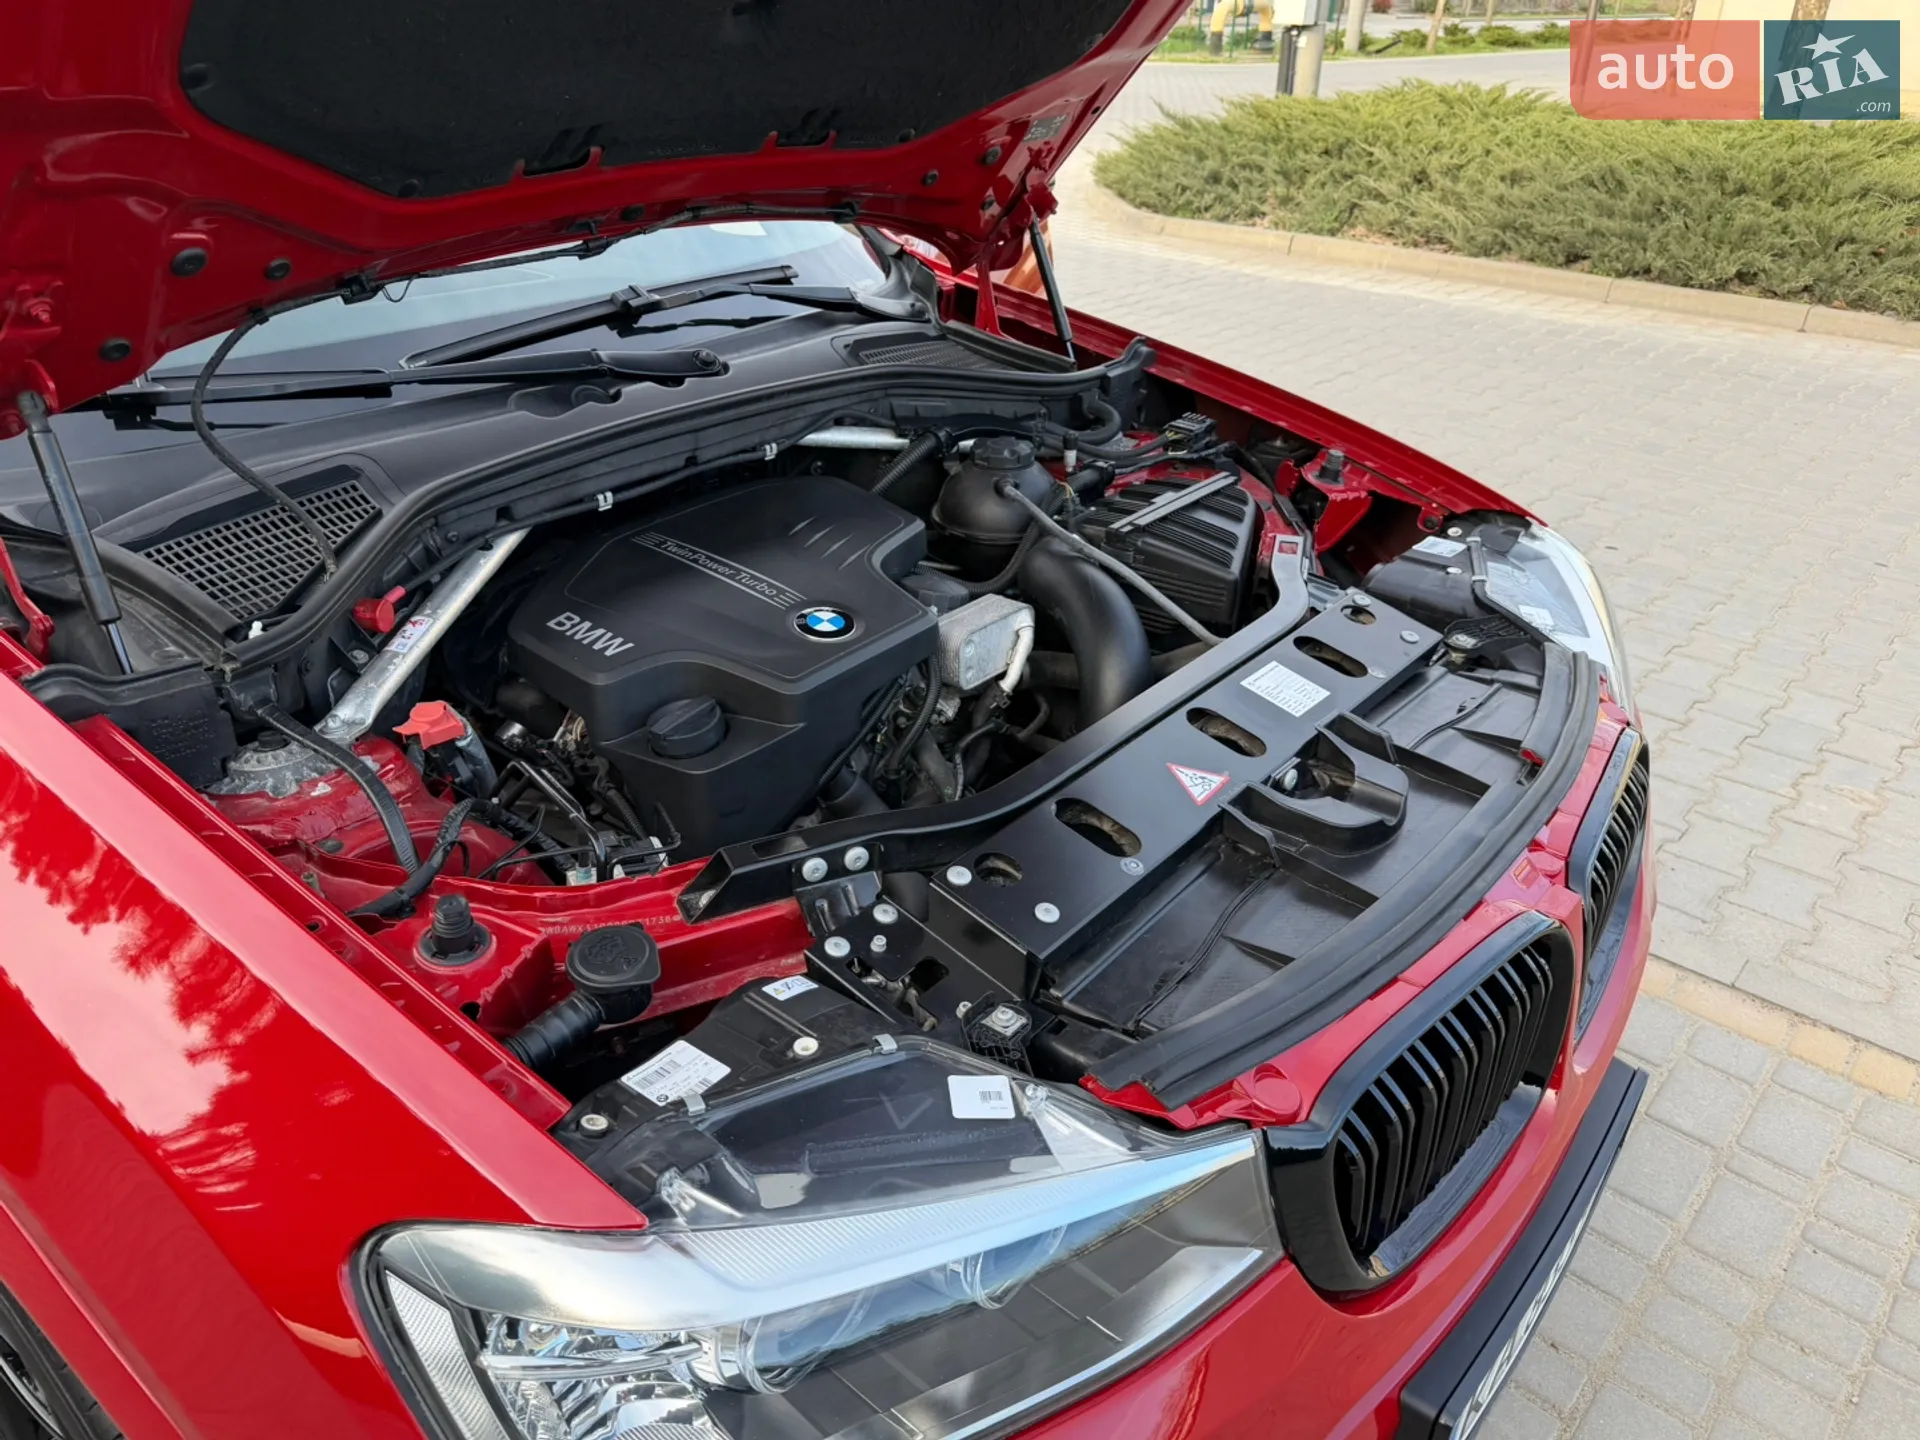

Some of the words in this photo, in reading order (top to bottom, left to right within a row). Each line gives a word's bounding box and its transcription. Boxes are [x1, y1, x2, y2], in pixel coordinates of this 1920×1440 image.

[661, 541, 737, 575] TwinPower
[735, 571, 777, 596] Turbo
[546, 611, 635, 656] BMW
